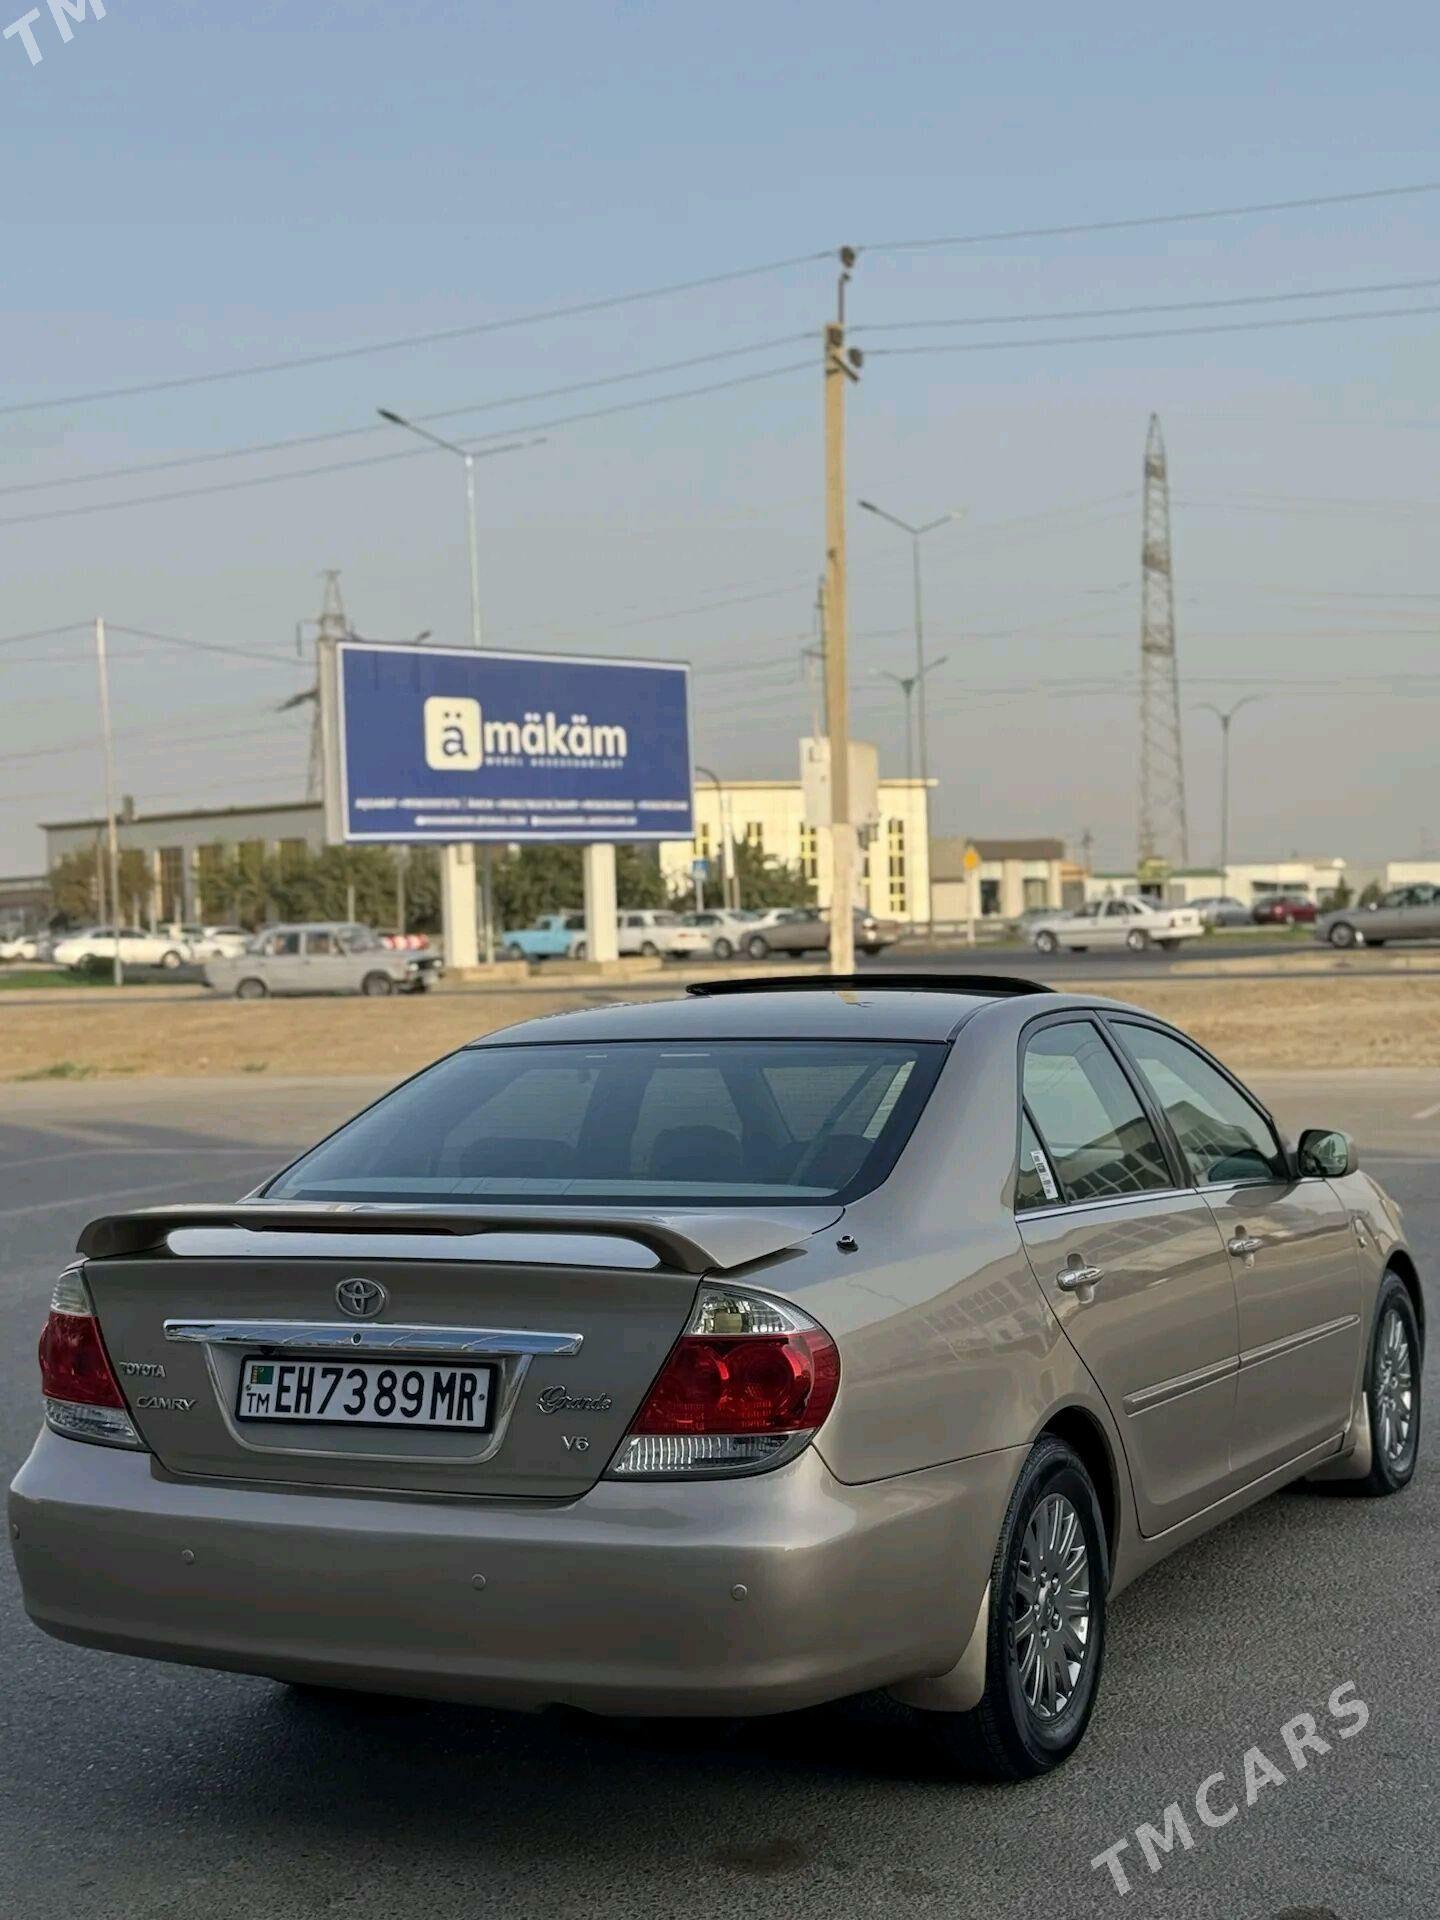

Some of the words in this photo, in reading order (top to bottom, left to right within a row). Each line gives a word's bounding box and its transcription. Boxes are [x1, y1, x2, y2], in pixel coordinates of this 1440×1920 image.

[484, 712, 627, 758] mäkäm
[119, 1361, 166, 1378] TOYOTA
[136, 1395, 196, 1411] CAMRY
[246, 1392, 270, 1414] TM
[561, 1435, 590, 1451] V6
